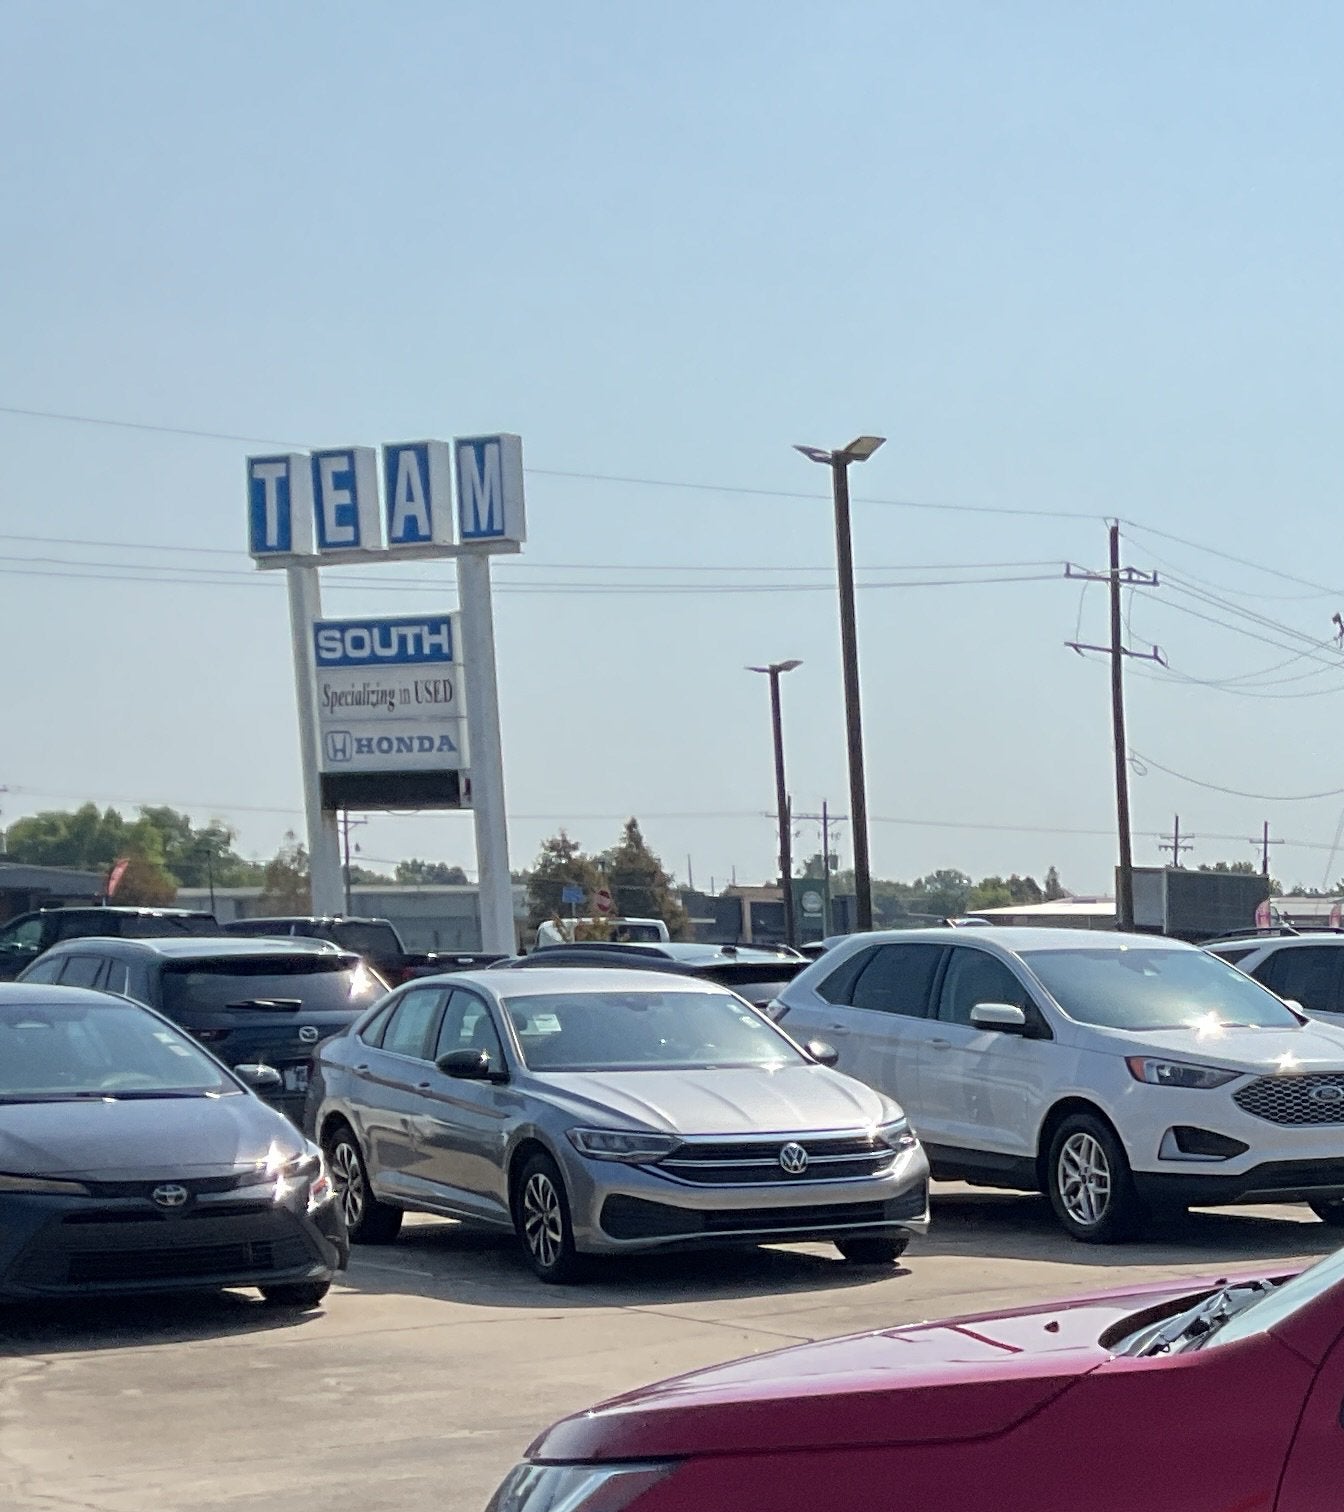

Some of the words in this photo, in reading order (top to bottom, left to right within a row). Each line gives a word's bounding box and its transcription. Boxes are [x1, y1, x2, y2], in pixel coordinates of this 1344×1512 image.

[252, 443, 503, 547] TEAM
[317, 625, 450, 660] SOUTH
[322, 682, 396, 714] Specializing
[399, 683, 411, 705] in
[413, 679, 453, 704] USED
[354, 734, 458, 755] HONDA
